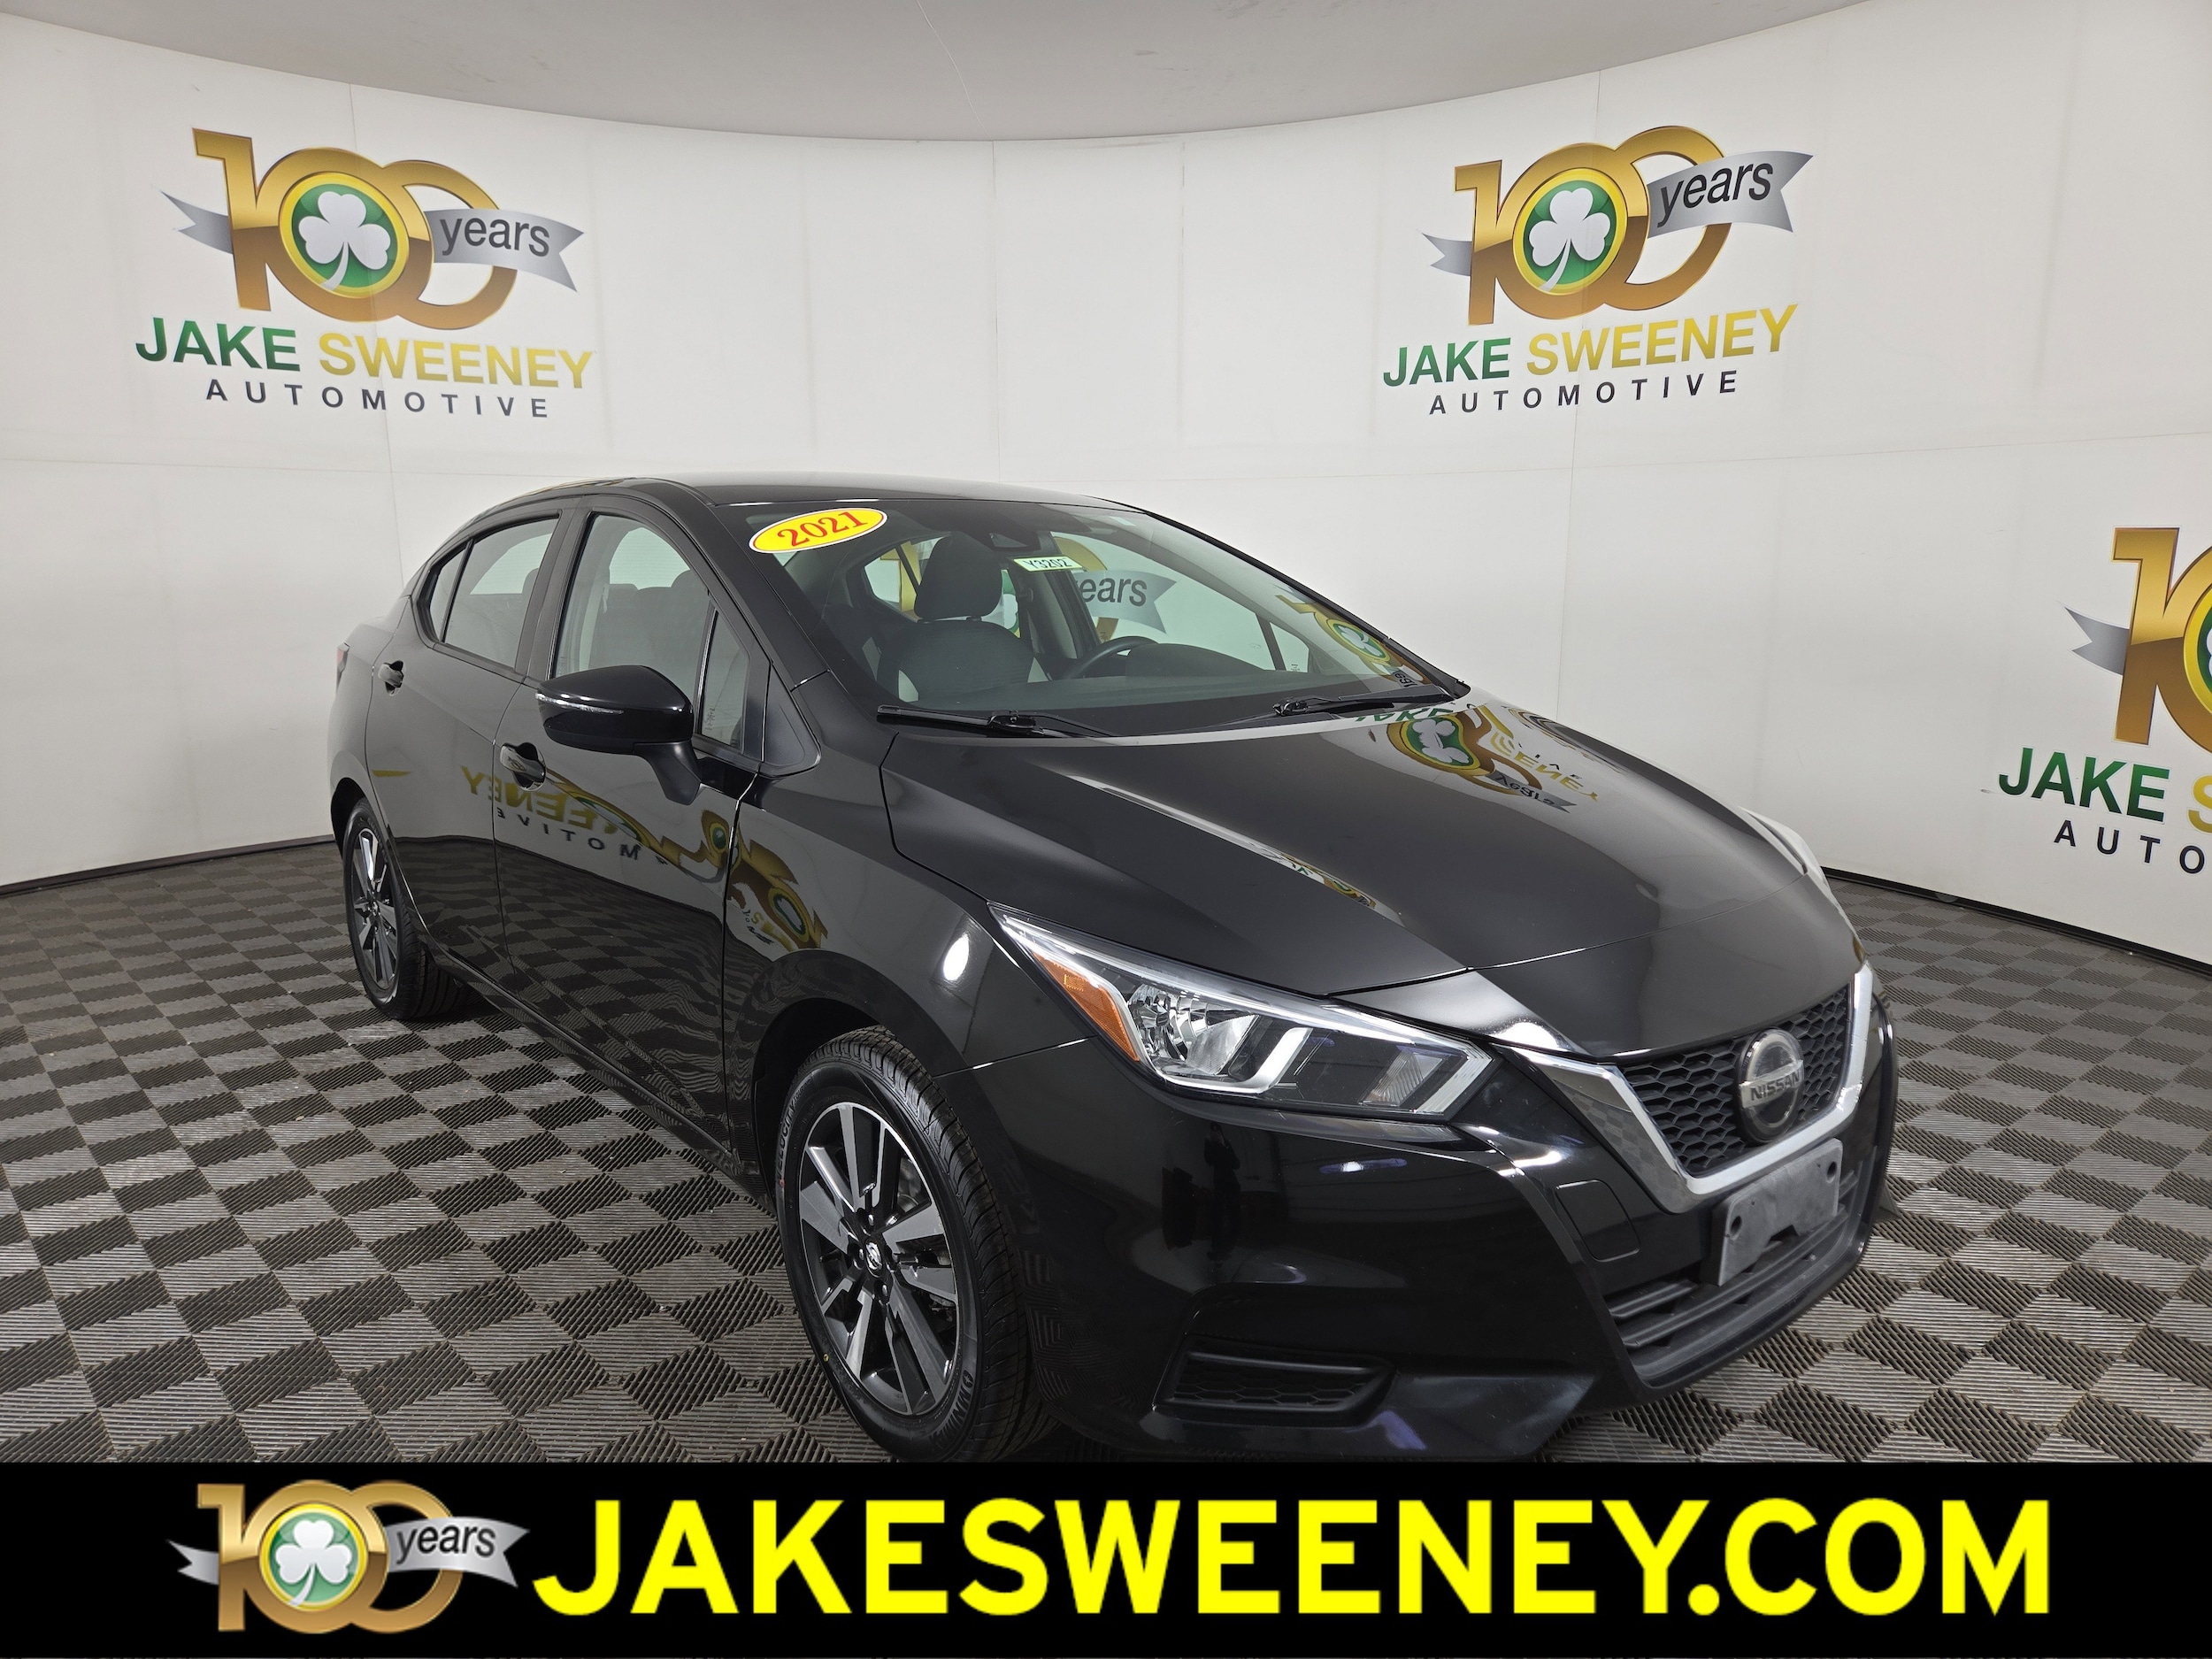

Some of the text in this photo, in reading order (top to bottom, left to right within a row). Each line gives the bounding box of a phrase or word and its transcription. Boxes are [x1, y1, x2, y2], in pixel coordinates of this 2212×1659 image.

[1657, 160, 1772, 227] years
[440, 215, 550, 257] years
[135, 317, 594, 389] JAKE SWEENEY
[1383, 303, 1799, 387] JAKE SWEENEY
[205, 378, 548, 419] AUTOMOTIVE
[1429, 369, 1739, 416] AUTOMOTIVE
[778, 510, 869, 548] 2021
[1077, 577, 1148, 608] ears
[1998, 746, 2170, 823] JAKE
[1750, 1071, 1801, 1102] NISSAN
